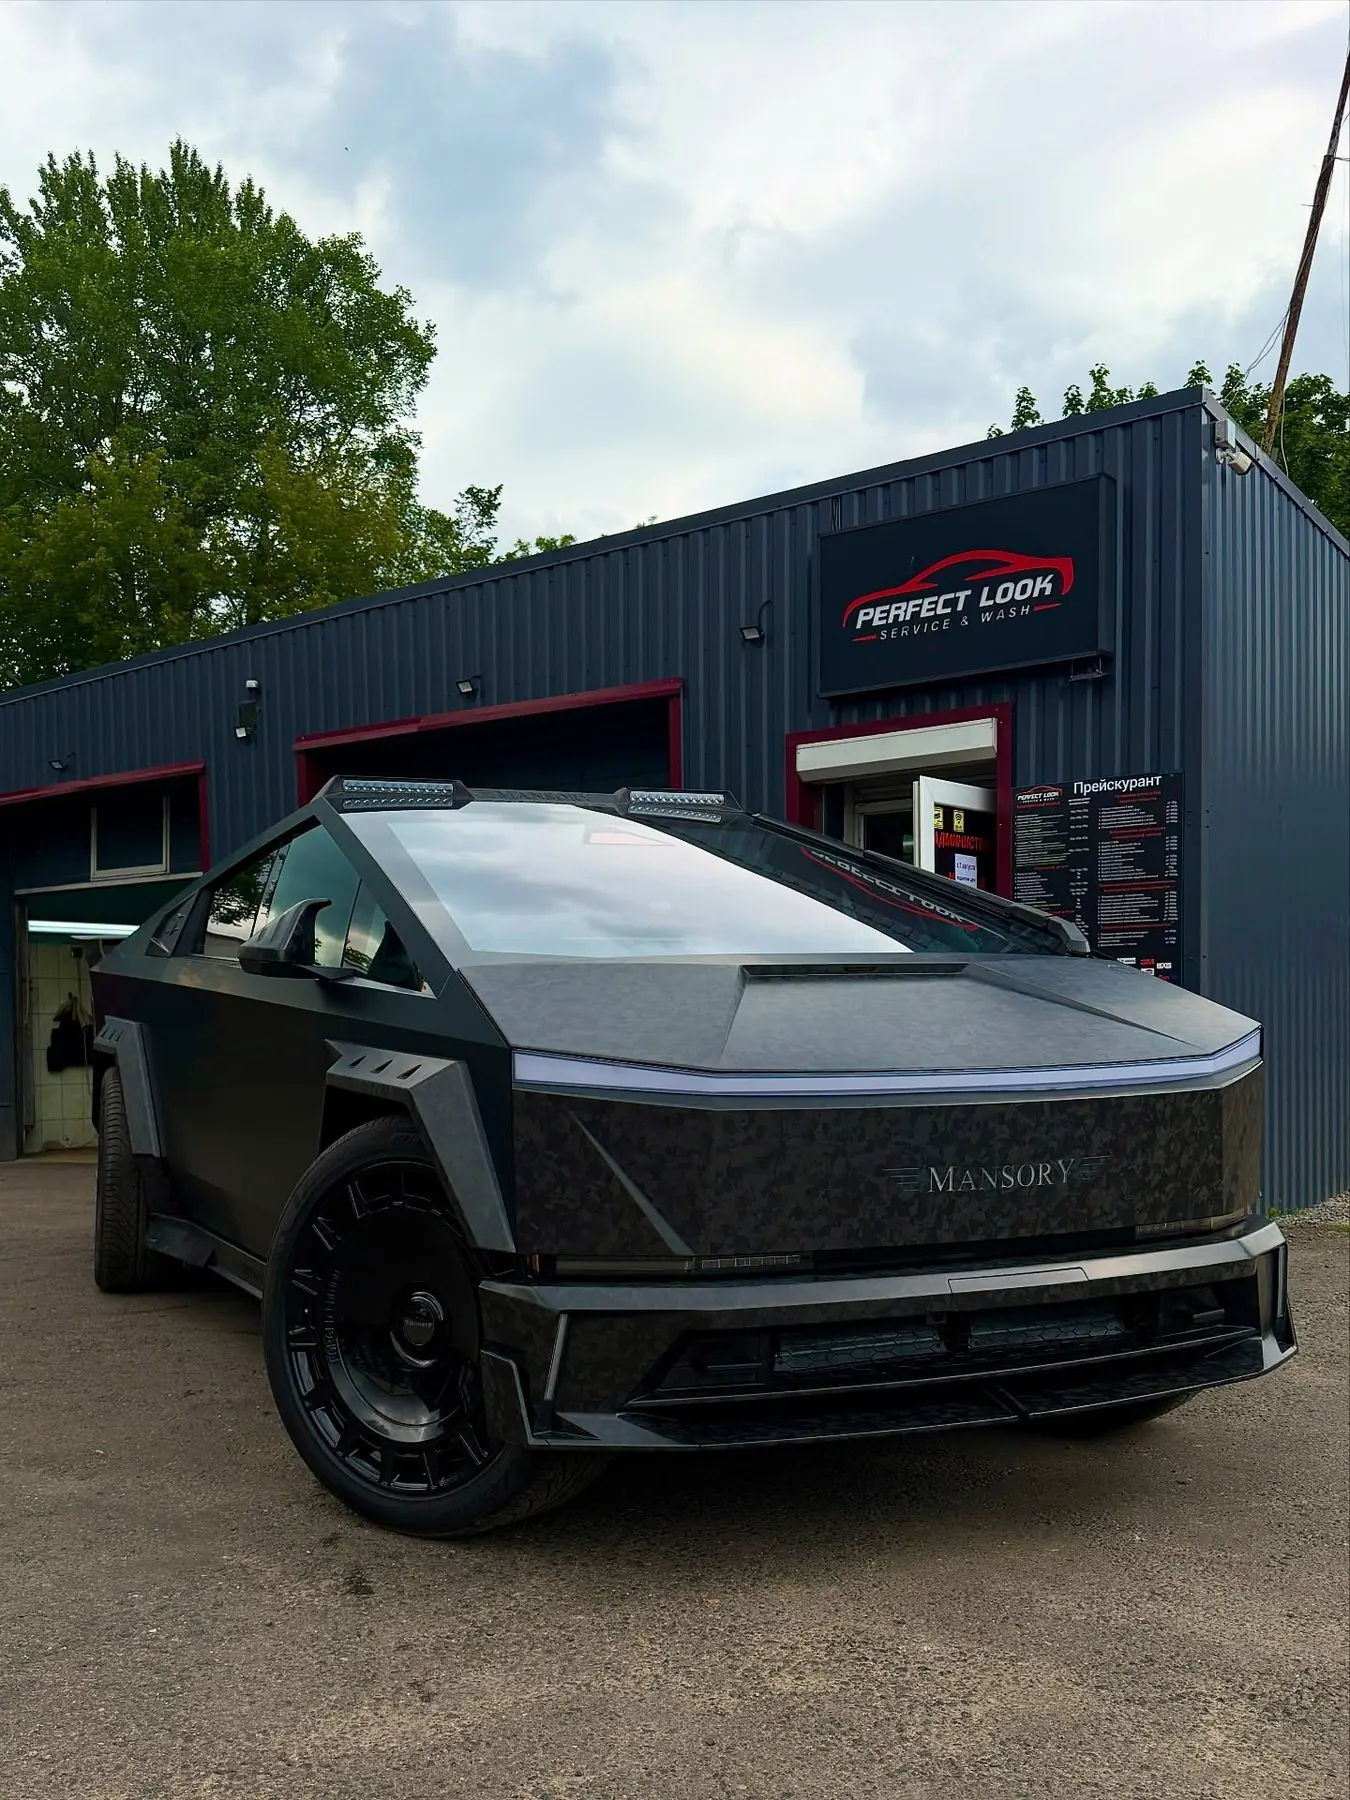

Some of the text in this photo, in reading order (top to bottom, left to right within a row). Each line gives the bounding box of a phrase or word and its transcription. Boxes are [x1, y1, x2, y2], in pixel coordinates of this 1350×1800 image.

[856, 574, 1055, 629] PERFECT LOOK
[879, 606, 1031, 640] SERVICE & WASH
[1074, 775, 1162, 795] Прейскурант
[928, 1158, 1075, 1192] MANSORY
